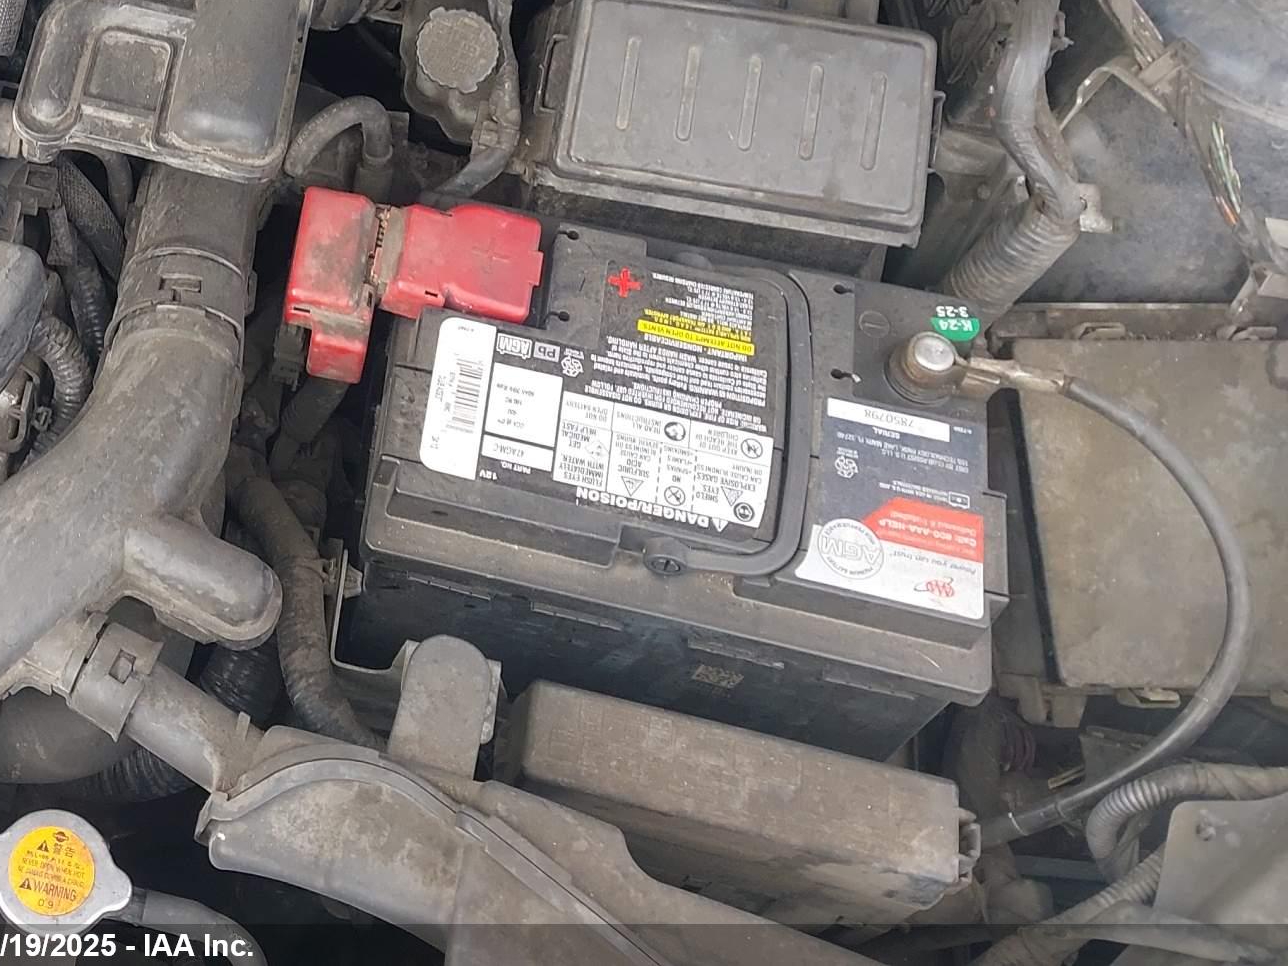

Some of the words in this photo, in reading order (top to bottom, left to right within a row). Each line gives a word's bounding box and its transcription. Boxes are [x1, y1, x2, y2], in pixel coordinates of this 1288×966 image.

[934, 303, 969, 319] 3-25
[938, 316, 973, 333] K-24
[665, 328, 683, 337] OPEN
[496, 335, 530, 355] AGM
[604, 335, 638, 349] HANDLING.
[643, 333, 703, 352] NONSERVICEABLE
[695, 335, 724, 347] ATTEMPT
[725, 341, 741, 350] NOT
[536, 345, 556, 358] Pb
[637, 342, 657, 353] AFTER
[657, 347, 679, 358] HANDS
[742, 345, 751, 353] DO
[596, 355, 615, 365] known
[678, 352, 697, 362] WASH
[706, 347, 748, 362] IMPORTANT
[592, 362, 613, 373] related
[612, 366, 624, 374] and
[614, 359, 643, 372] chemicals
[739, 364, 768, 377] California
[590, 378, 614, 390] FOLLOW
[667, 377, 688, 390] Battery
[707, 373, 735, 385] California
[583, 383, 622, 400] DISASSEMBLE
[622, 391, 633, 402] NOT
[627, 387, 654, 399] INVERTED
[672, 390, 700, 403] CHARGING
[632, 393, 642, 404] DO
[653, 394, 665, 402] FOR
[664, 396, 706, 411] RECOMMENDED
[699, 397, 722, 408] PROPER
[725, 392, 766, 406] PROPOSITION
[594, 406, 608, 415] OPEN
[662, 402, 672, 411] OR
[671, 405, 702, 418] EXPLOSION
[707, 406, 718, 414] NOT
[584, 411, 597, 420] NOT
[597, 414, 607, 422] DO
[615, 409, 663, 428] INSTRUCTIONS
[717, 415, 725, 423] OF
[862, 408, 915, 428] 7850798
[560, 420, 578, 432] FAST
[578, 424, 597, 436] HELP
[631, 421, 643, 430] ALL
[643, 424, 661, 434] READ
[558, 427, 590, 442] MEDICAL
[706, 426, 739, 442] CHILDREN
[870, 426, 900, 439] SERIAL
[567, 439, 581, 449] GET
[701, 434, 725, 446] REACH
[726, 440, 738, 448] THE
[882, 441, 899, 450] LAKE
[707, 442, 720, 452] OUT
[721, 446, 738, 456] KEEP
[619, 448, 638, 459] CAUSE
[638, 453, 651, 462] CAN
[916, 449, 957, 463] TECHNOLOGY
[513, 463, 531, 474] PART
[586, 460, 604, 470] WITH
[625, 457, 642, 468] ACID
[927, 458, 944, 468] CLUB
[478, 468, 498, 480] 12V
[558, 460, 604, 478] IMMEDIATELY
[616, 463, 649, 478] SULFURIC
[694, 462, 728, 477] BLINDNESS
[752, 468, 763, 476] OR
[562, 470, 580, 481] EYES
[580, 475, 602, 487] FLUSH
[670, 474, 681, 483] NO
[695, 471, 718, 483] GASES
[729, 470, 748, 481] CAUSE
[749, 475, 762, 484] CAN
[719, 476, 756, 492] EXPLOSIVE
[694, 490, 719, 503] SHIELD
[574, 484, 710, 529] DANGER/POISON
[877, 517, 953, 541] 800-AAA-HELP
[954, 534, 977, 546] Call:
[818, 535, 881, 566] AGM
[930, 557, 947, 566] you
[949, 562, 976, 574] Power
[51, 841, 76, 858] 警告
[21, 857, 38, 866] NEVER
[39, 861, 54, 872] OPEN
[55, 865, 72, 876] WHEN
[31, 879, 77, 901] WARNING
